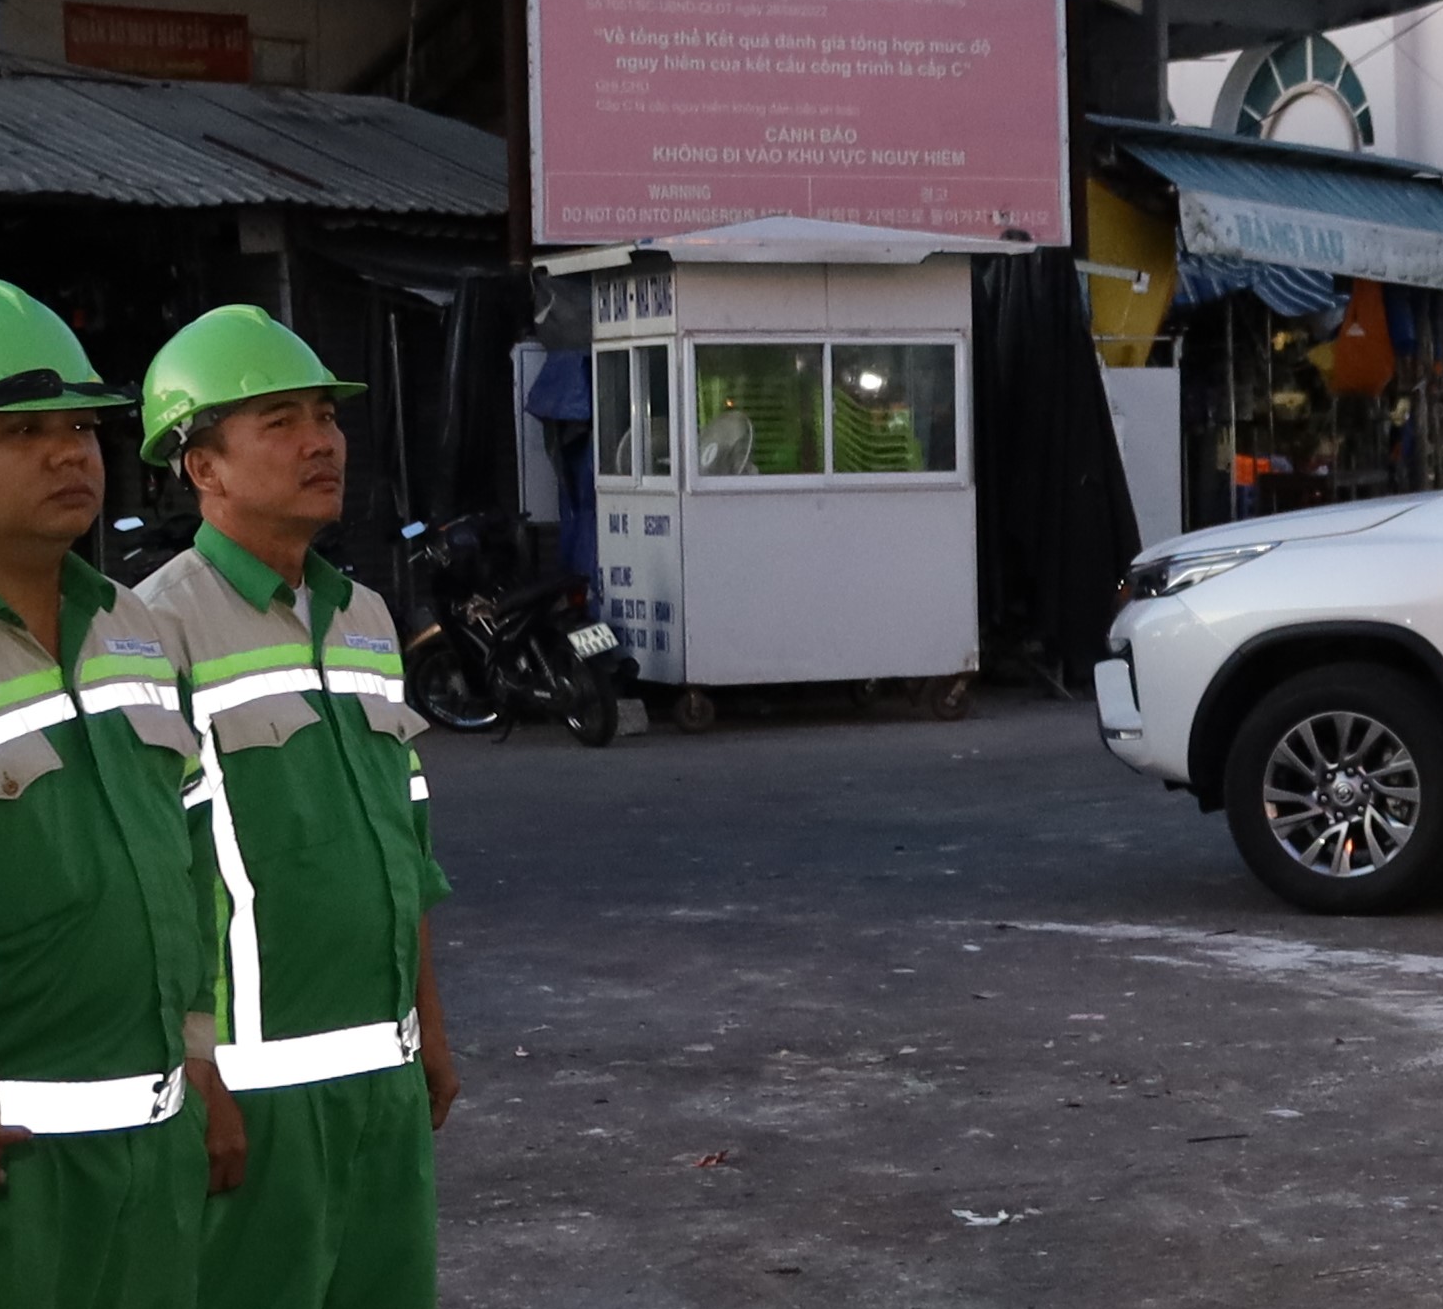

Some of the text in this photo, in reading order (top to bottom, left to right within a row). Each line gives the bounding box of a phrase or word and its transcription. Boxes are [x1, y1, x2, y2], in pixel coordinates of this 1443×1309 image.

[722, 147, 742, 164] ĐI
[647, 184, 712, 200] WARNING
[562, 206, 582, 223] DO
[585, 207, 611, 223] NOT
[615, 207, 636, 224] GO
[639, 208, 672, 224] INTO
